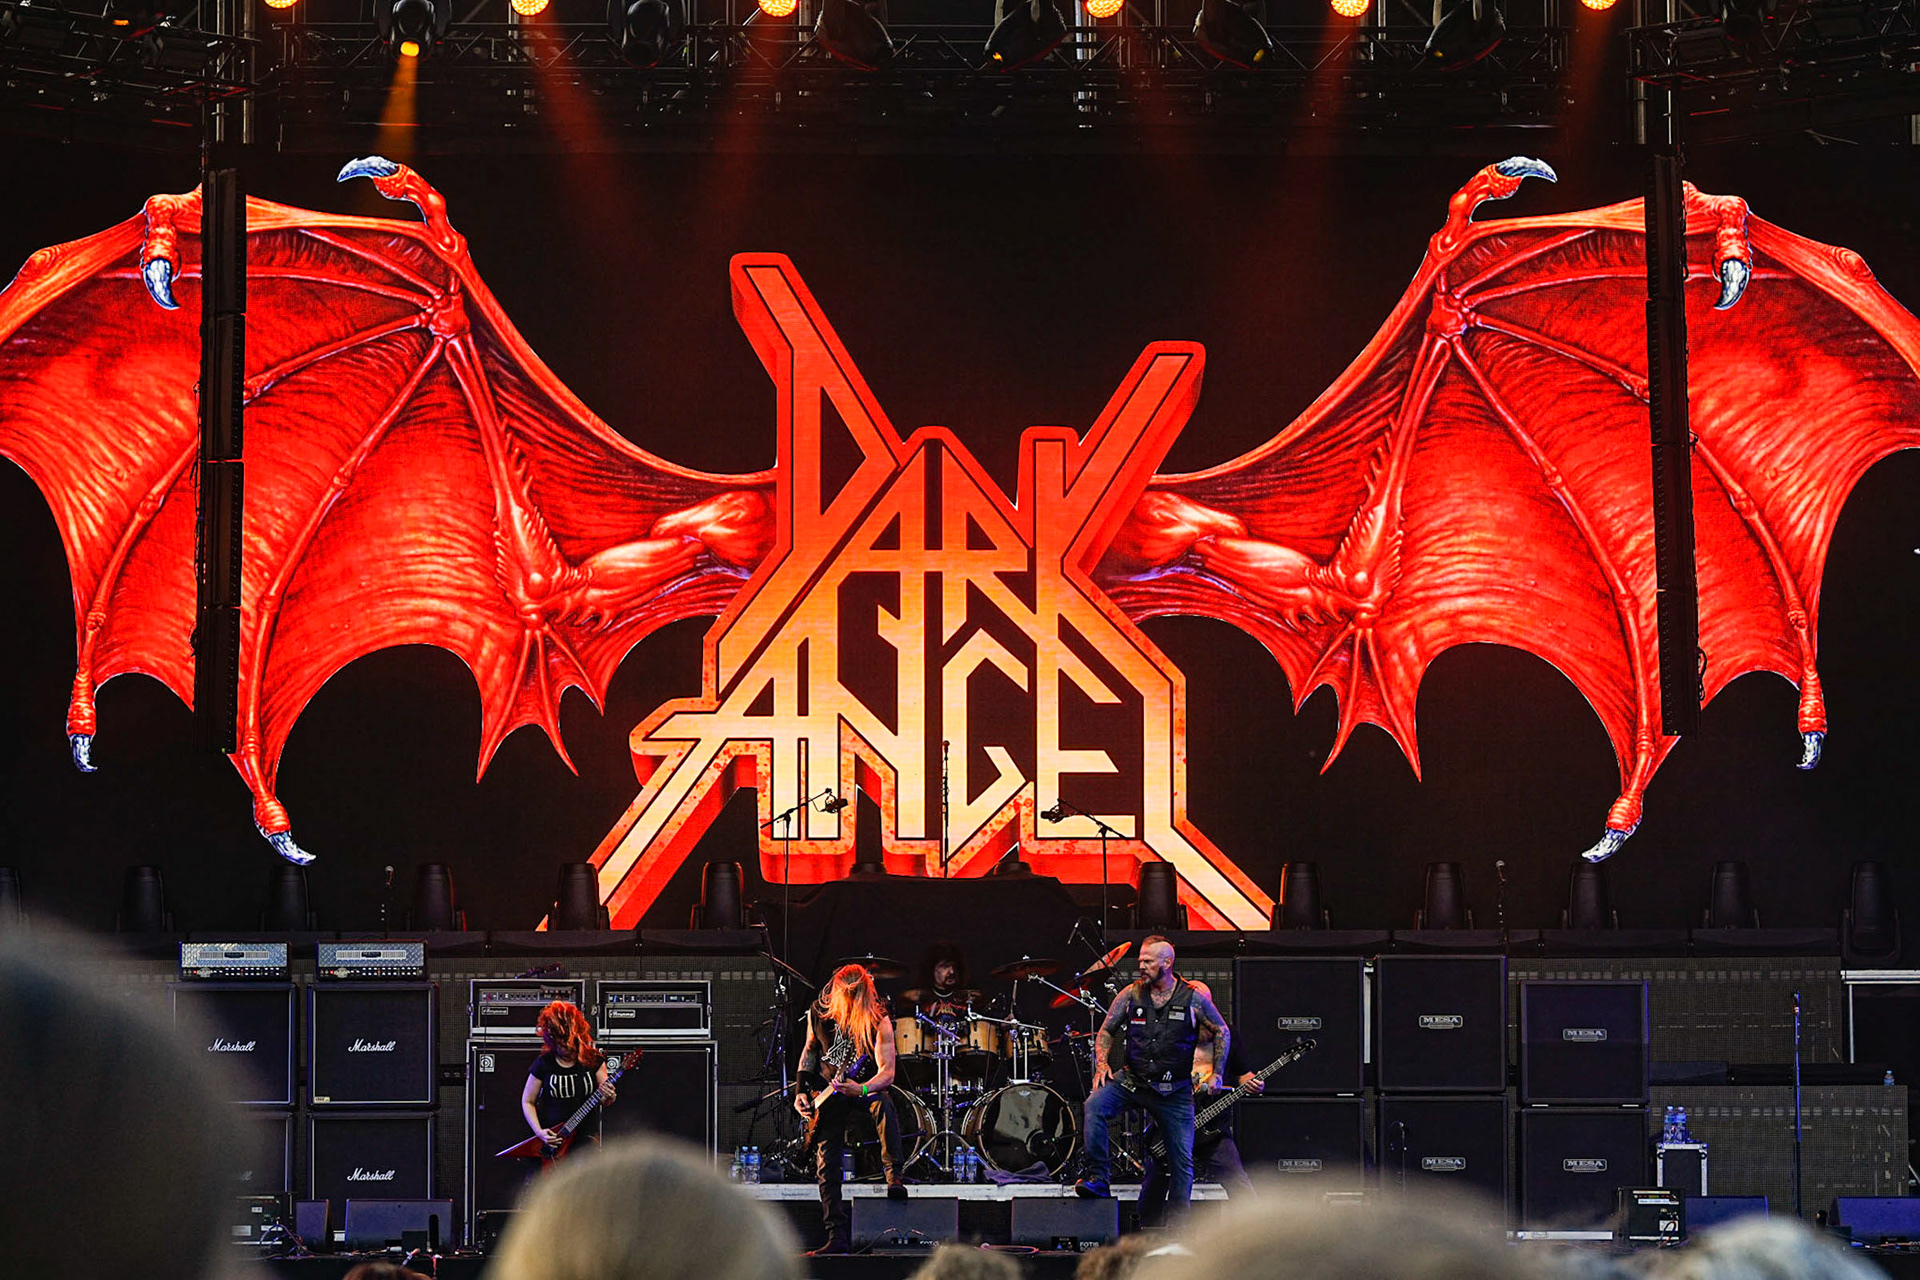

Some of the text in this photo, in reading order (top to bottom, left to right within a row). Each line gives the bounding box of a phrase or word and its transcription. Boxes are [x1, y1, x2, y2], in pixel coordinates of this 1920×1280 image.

[729, 252, 1206, 645] DARK
[208, 1038, 256, 1052] Marshall
[348, 1038, 396, 1052] Marshall
[347, 1167, 395, 1181] Marshall
